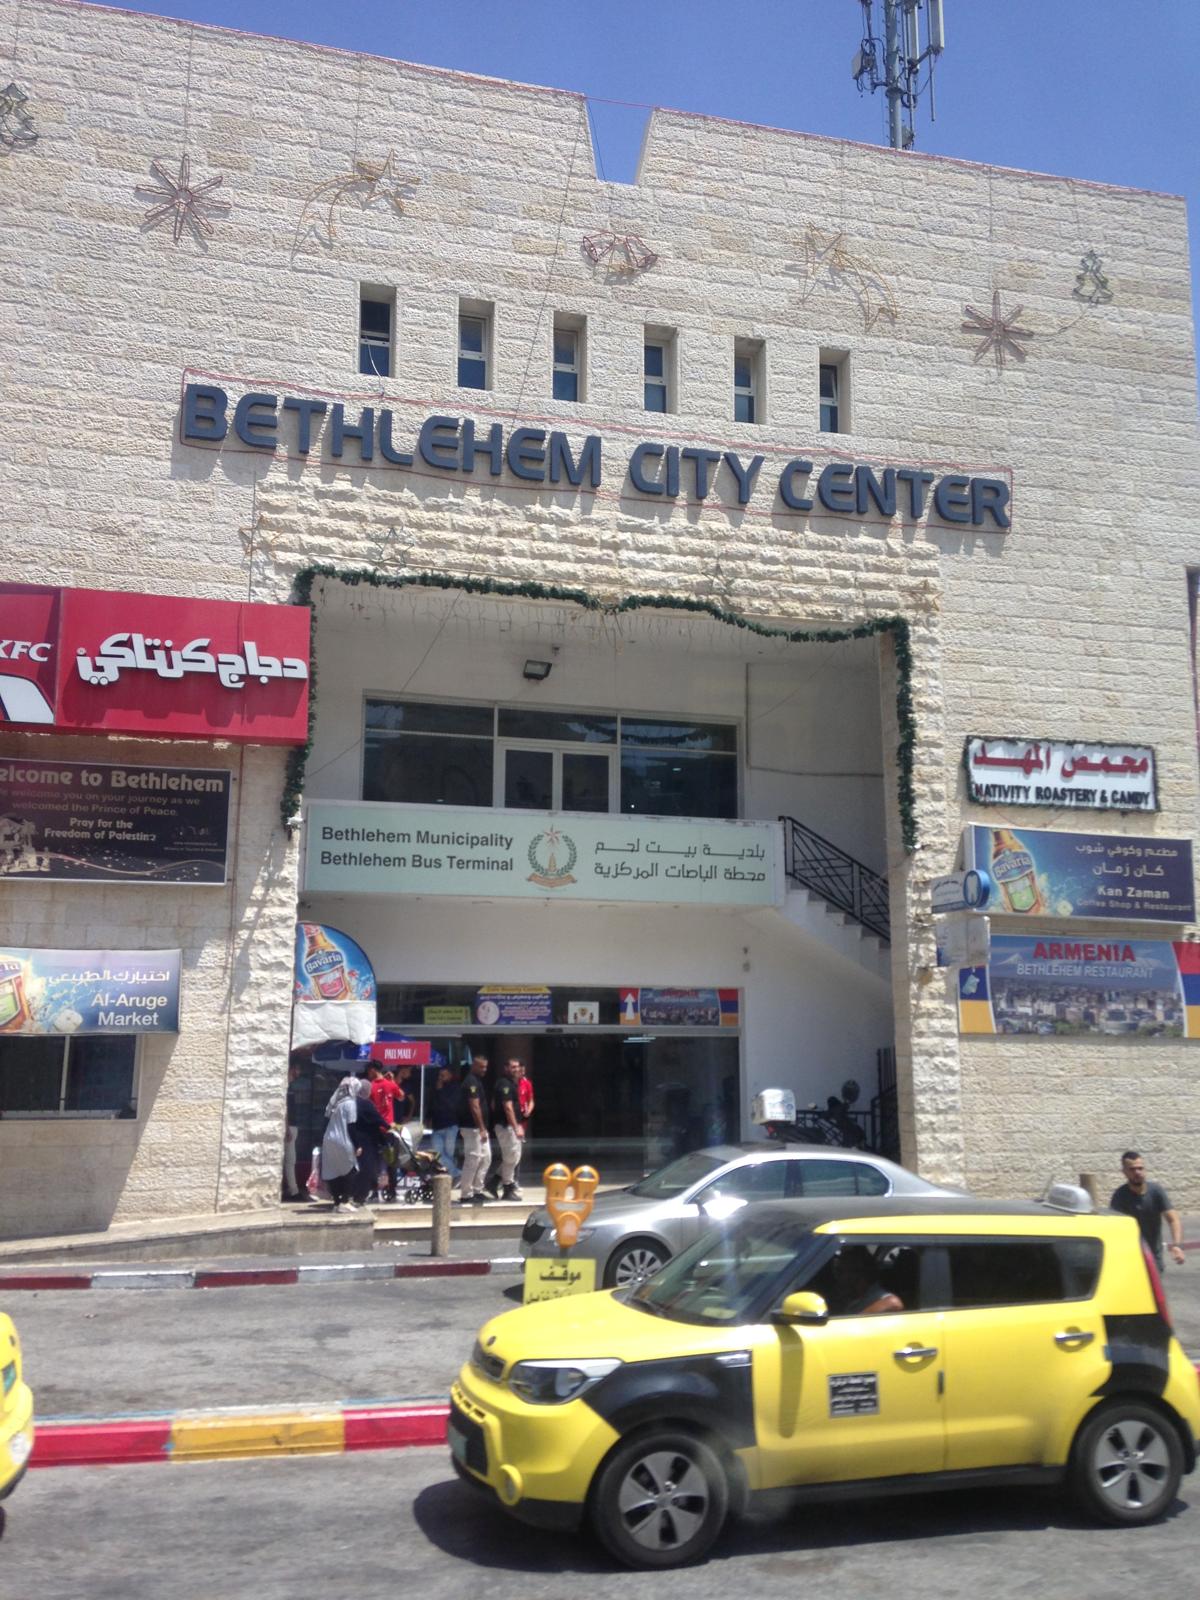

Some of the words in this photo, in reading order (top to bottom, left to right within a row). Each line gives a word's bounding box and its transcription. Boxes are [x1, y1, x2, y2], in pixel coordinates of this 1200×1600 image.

[185, 384, 601, 488] BETHLEHEM
[629, 442, 765, 504] CITY
[780, 460, 1011, 527] CENTER
[0, 640, 51, 662] KFC
[76, 633, 216, 686] كنتاكي
[217, 641, 308, 688] دجاج
[973, 743, 1051, 775] المهد
[1061, 755, 1148, 777] محمص
[80, 770, 103, 786] to
[111, 771, 224, 792] Bethlehem
[63, 792, 82, 801] you
[101, 794, 125, 804] your
[128, 795, 168, 805] journey
[974, 784, 1031, 799] NATIVITY
[1036, 786, 1097, 802] ROASTERY
[1100, 792, 1107, 803] &
[1111, 790, 1150, 805] CANDY
[12, 801, 69, 811] welcomed
[72, 803, 89, 812] the
[92, 804, 126, 814] Prince
[129, 806, 140, 815] of
[70, 818, 94, 829] Pray
[98, 818, 113, 828] for
[116, 819, 133, 829] the
[44, 828, 90, 839] Freedom
[94, 829, 105, 840] of
[109, 830, 156, 841] Palestine
[321, 827, 411, 843] Bethlehem
[416, 830, 513, 850] Municipality
[595, 838, 640, 854] لحم
[646, 841, 697, 858] بيت
[703, 844, 765, 861] بلدية
[320, 851, 406, 867] Bethlehem
[411, 854, 442, 869] Bus
[446, 856, 513, 871] Terminal
[1093, 862, 1130, 877] زمان
[594, 862, 658, 879] المركزية
[665, 864, 717, 882] الباصات
[724, 866, 765, 881] محطة
[1134, 864, 1164, 877] كان
[1097, 885, 1123, 897] Kan
[1127, 887, 1170, 899] Zaman
[1109, 900, 1132, 909] Shop
[1033, 942, 1136, 962] ARMENIA
[306, 952, 343, 972] Bavaria
[1017, 963, 1083, 977] BETHLEHEM
[1084, 966, 1154, 978] RESTAURANT
[91, 993, 168, 1010] Al-Aruge
[98, 1012, 160, 1026] Market
